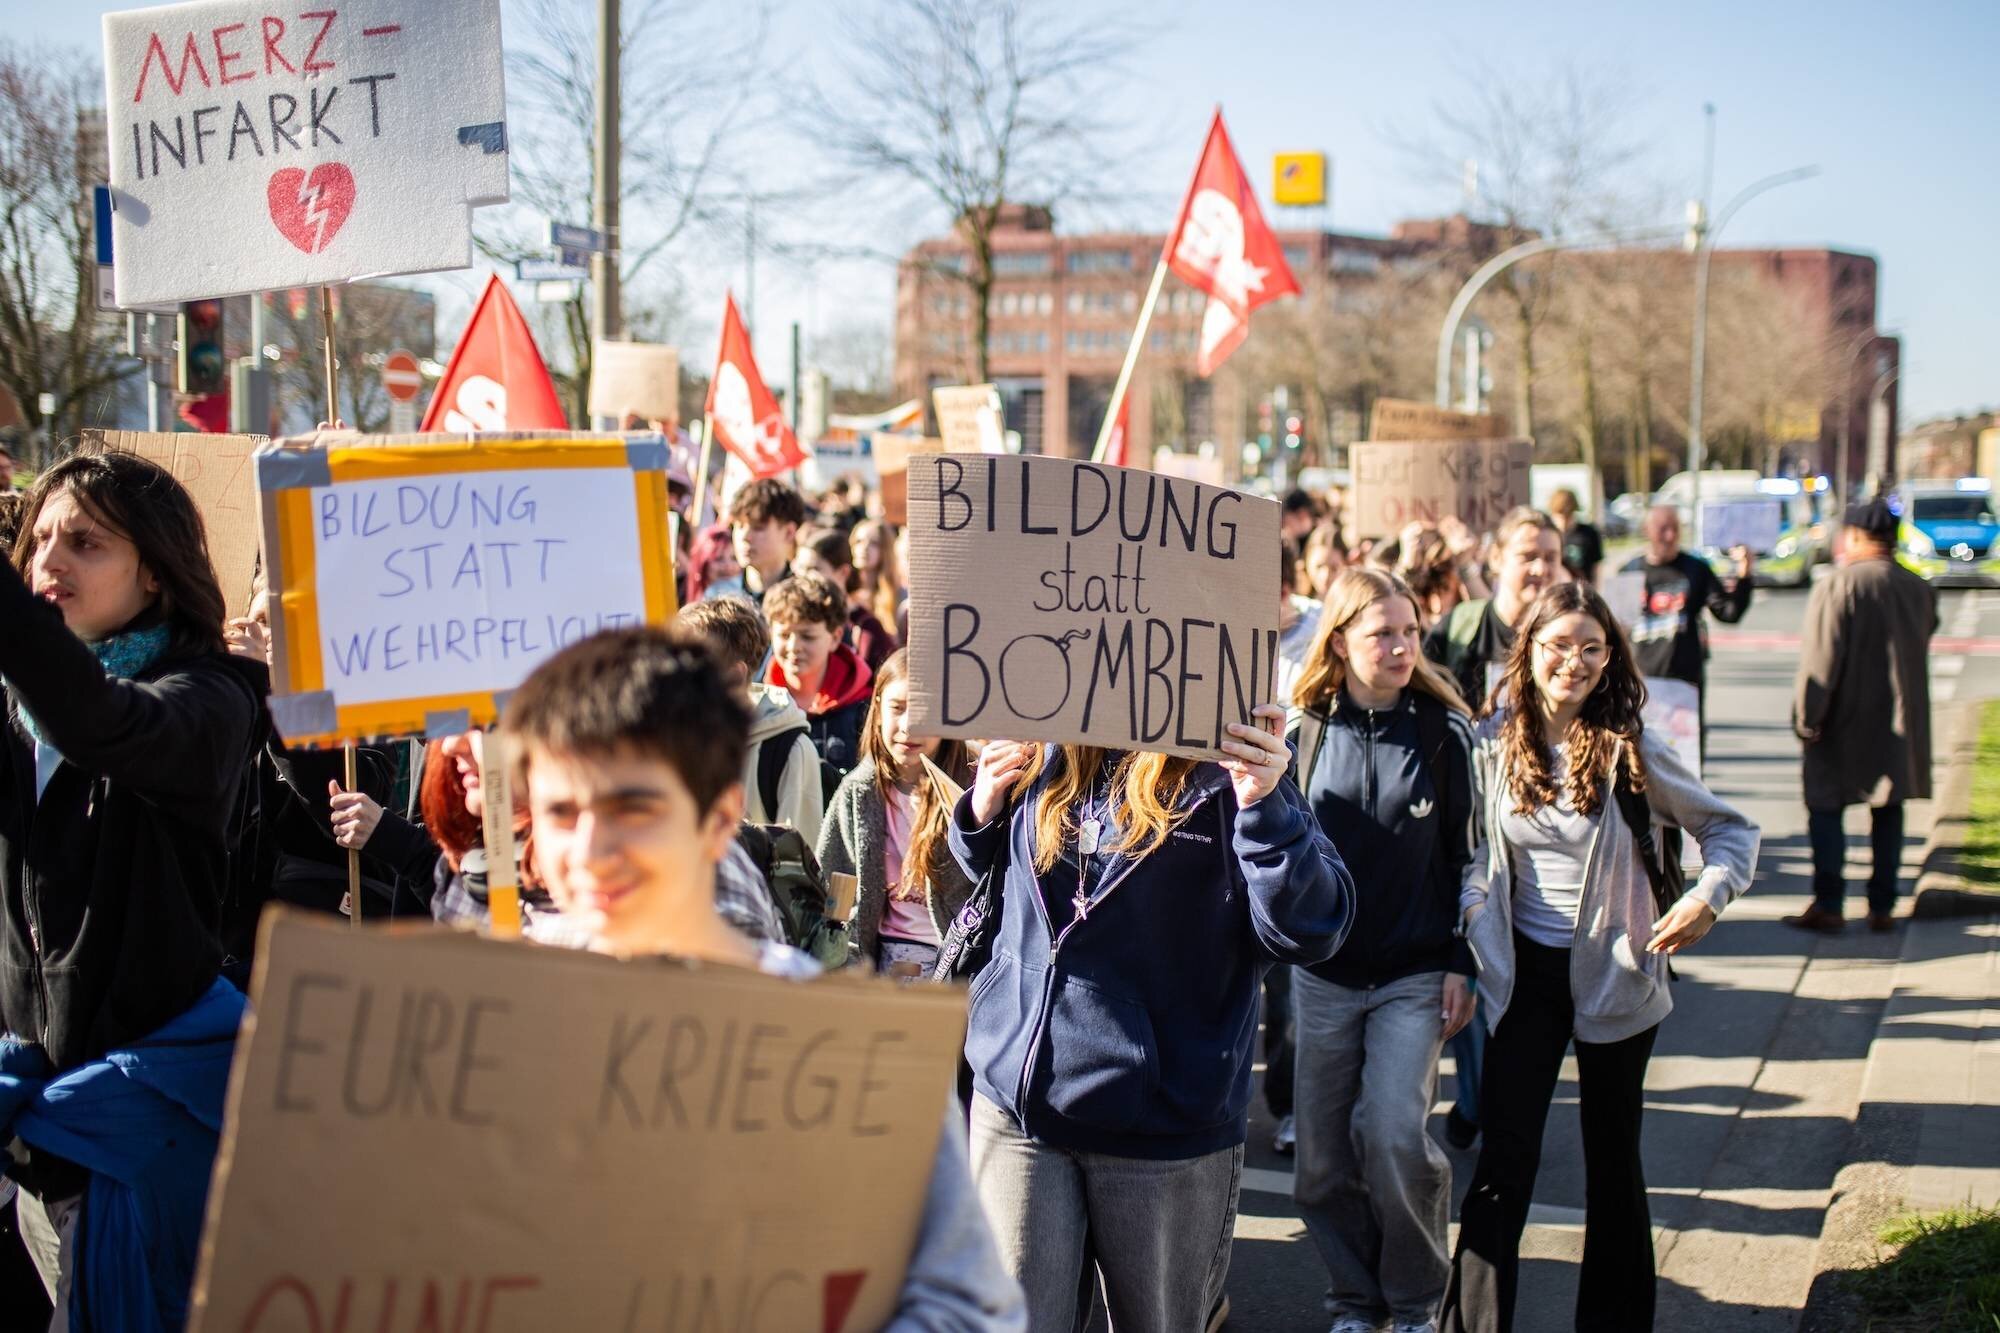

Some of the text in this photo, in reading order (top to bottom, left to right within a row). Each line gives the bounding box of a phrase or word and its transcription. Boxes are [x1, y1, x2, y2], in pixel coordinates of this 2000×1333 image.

[132, 72, 396, 180] INFARKT
[321, 480, 537, 541] BILDUNG
[933, 457, 1243, 560] BILDUNG
[377, 538, 567, 598] STATT
[1033, 541, 1151, 614] statt
[272, 972, 909, 1137] EURE KRIEGE
